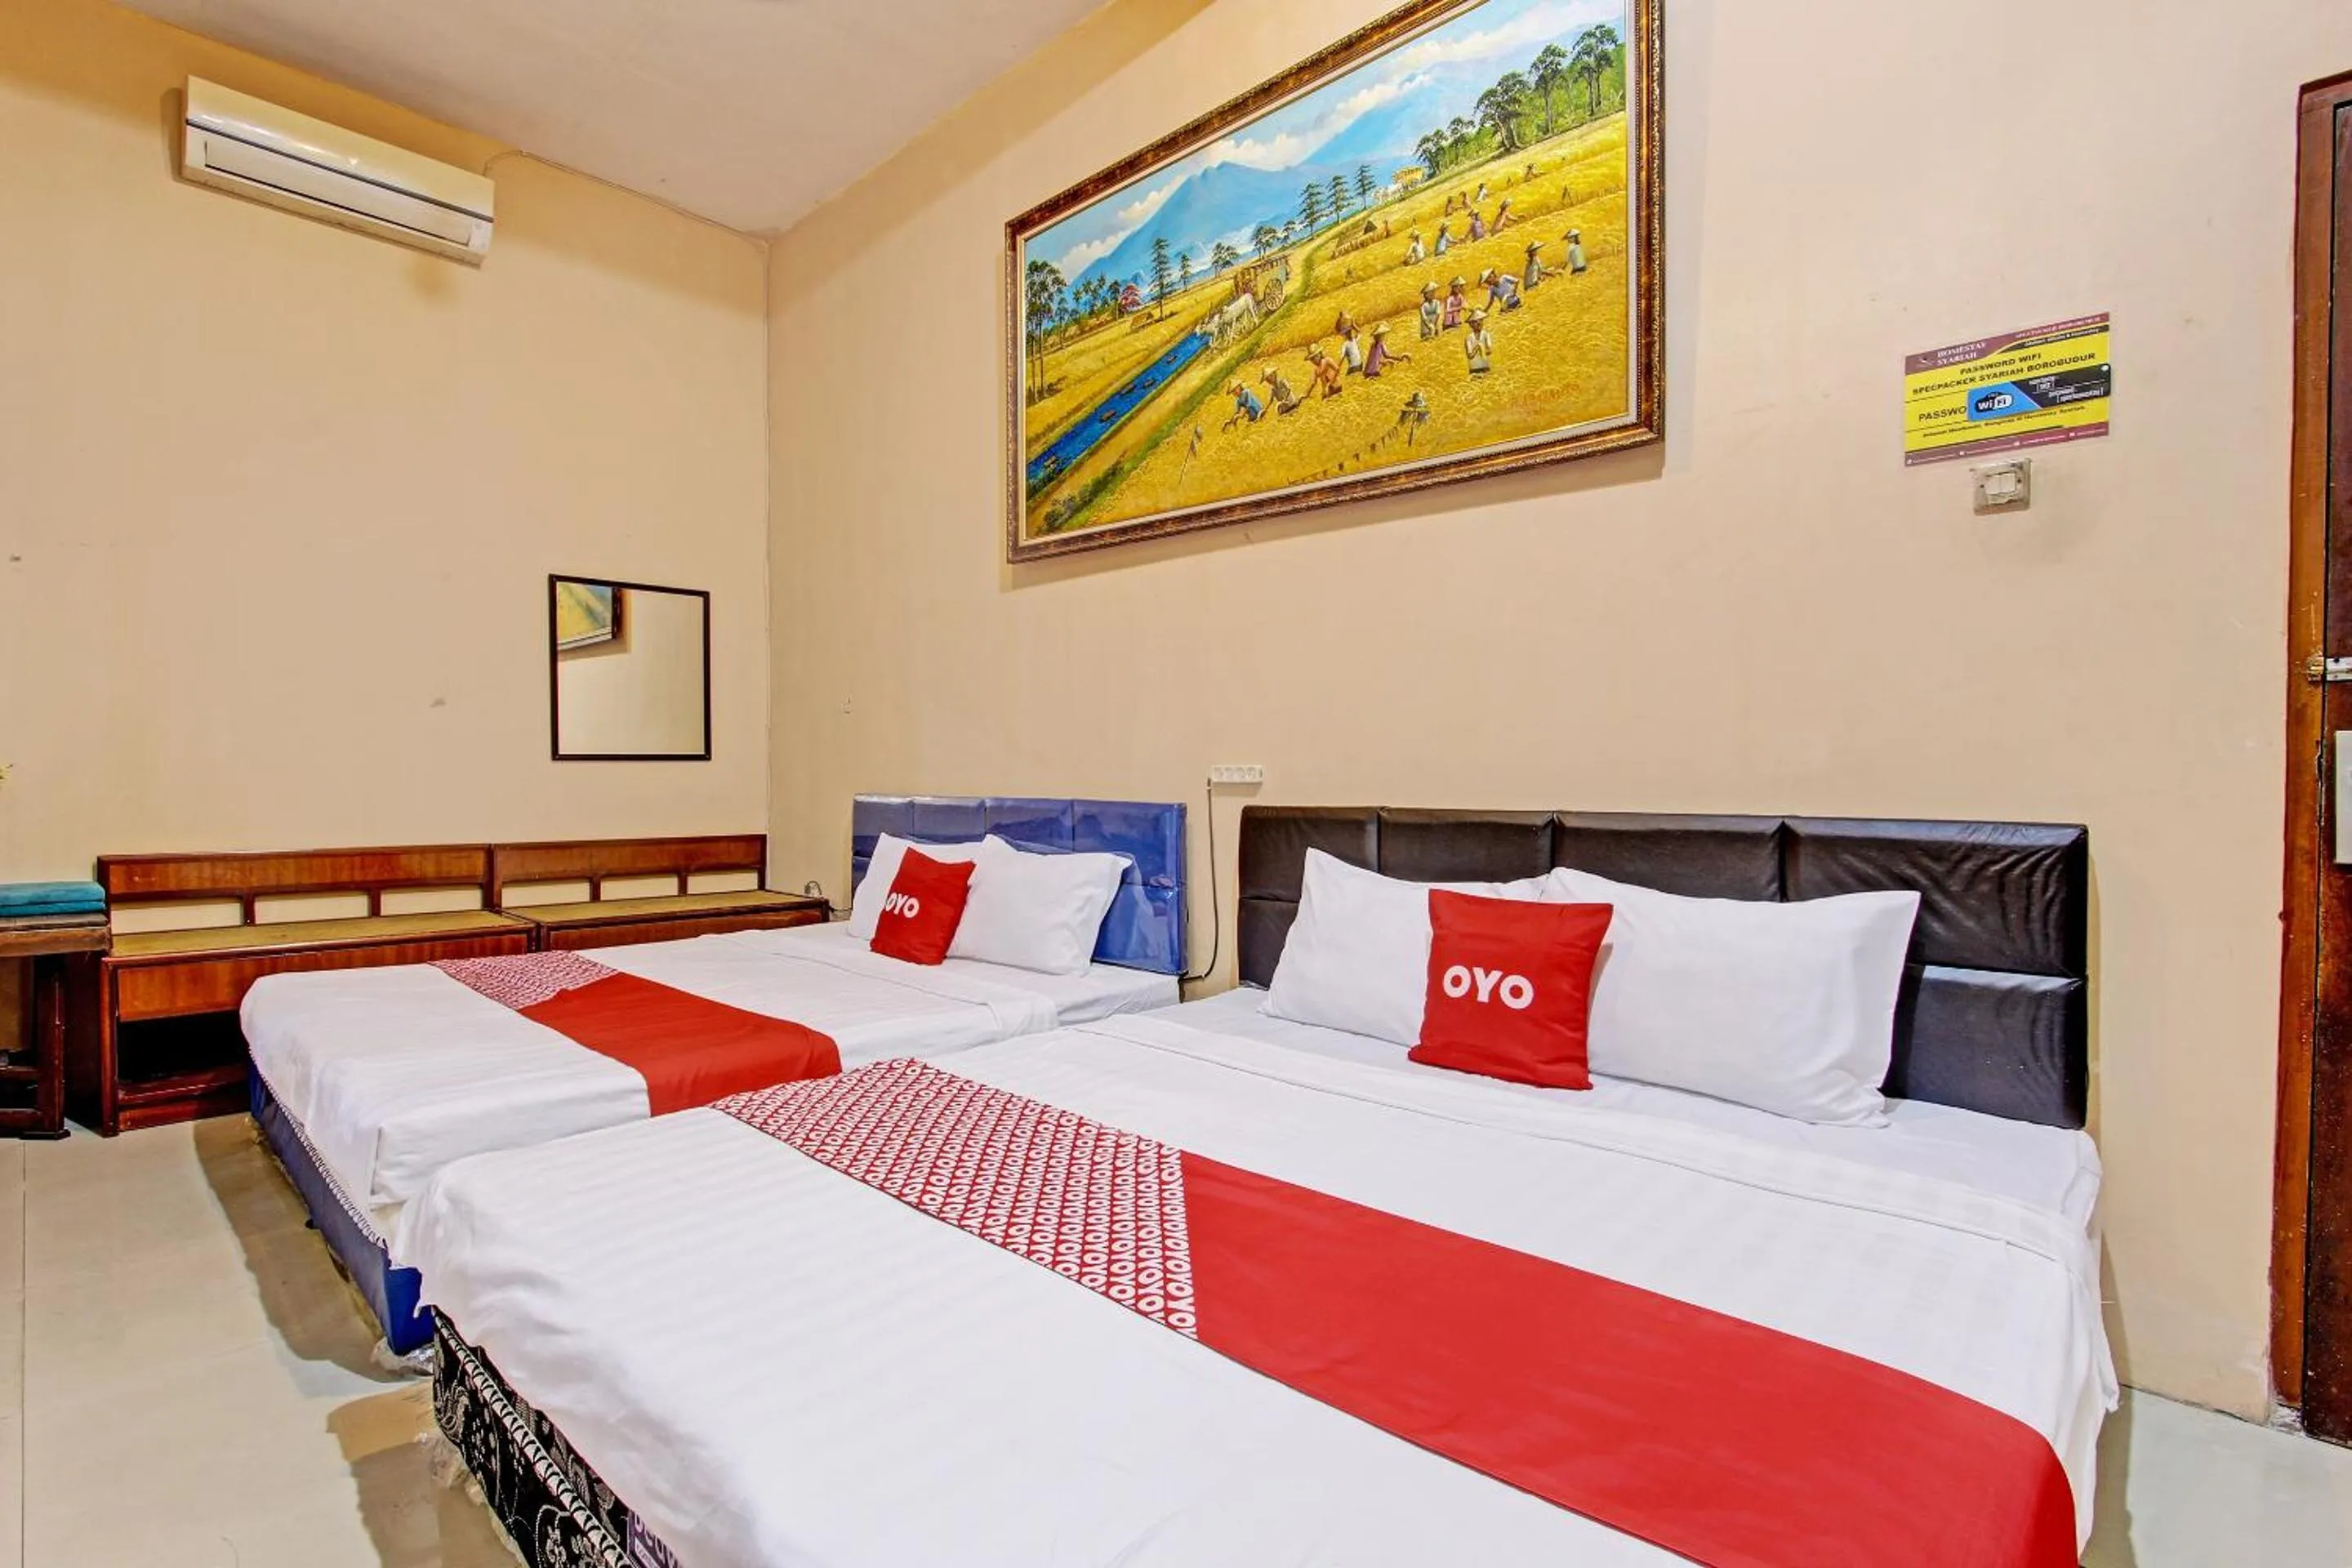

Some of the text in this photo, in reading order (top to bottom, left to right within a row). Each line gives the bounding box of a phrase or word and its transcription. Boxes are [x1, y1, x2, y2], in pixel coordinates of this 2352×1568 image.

[1937, 342, 1986, 357] HOMESTAY
[1937, 352, 1976, 366] SYARIAH
[1960, 353, 2041, 375] PASSWORD WIFI
[1979, 368, 2024, 381] SYARIAH
[2027, 353, 2096, 372] BOROBUDUR
[885, 892, 920, 918] OYO
[1443, 964, 1534, 1009] OYO
